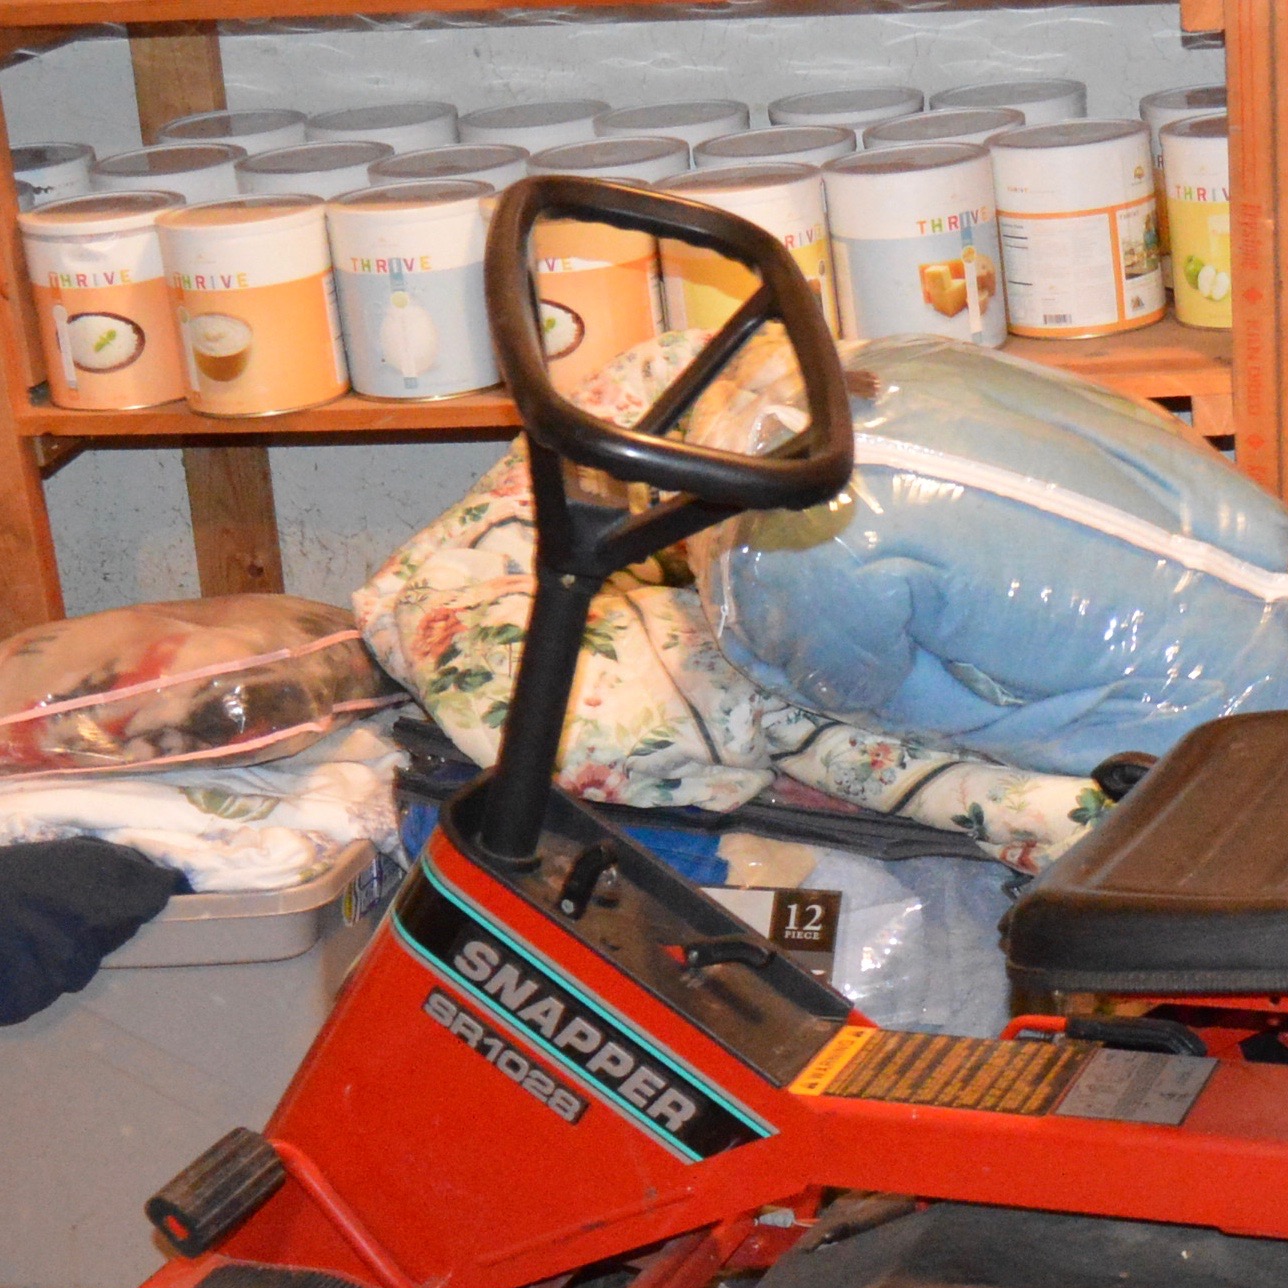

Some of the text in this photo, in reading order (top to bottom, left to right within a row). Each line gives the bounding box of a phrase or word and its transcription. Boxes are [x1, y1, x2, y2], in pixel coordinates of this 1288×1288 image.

[1175, 185, 1229, 202] THRIV
[916, 206, 990, 236] THRIVE
[784, 223, 824, 249] RIVE
[350, 255, 432, 273] THRIVE
[47, 268, 133, 288] THRIVE
[172, 272, 249, 290] THRIVE
[784, 903, 823, 931] 12
[784, 929, 820, 940] PIECE
[452, 939, 698, 1133] SNAPPER
[423, 992, 582, 1125] SR1028
